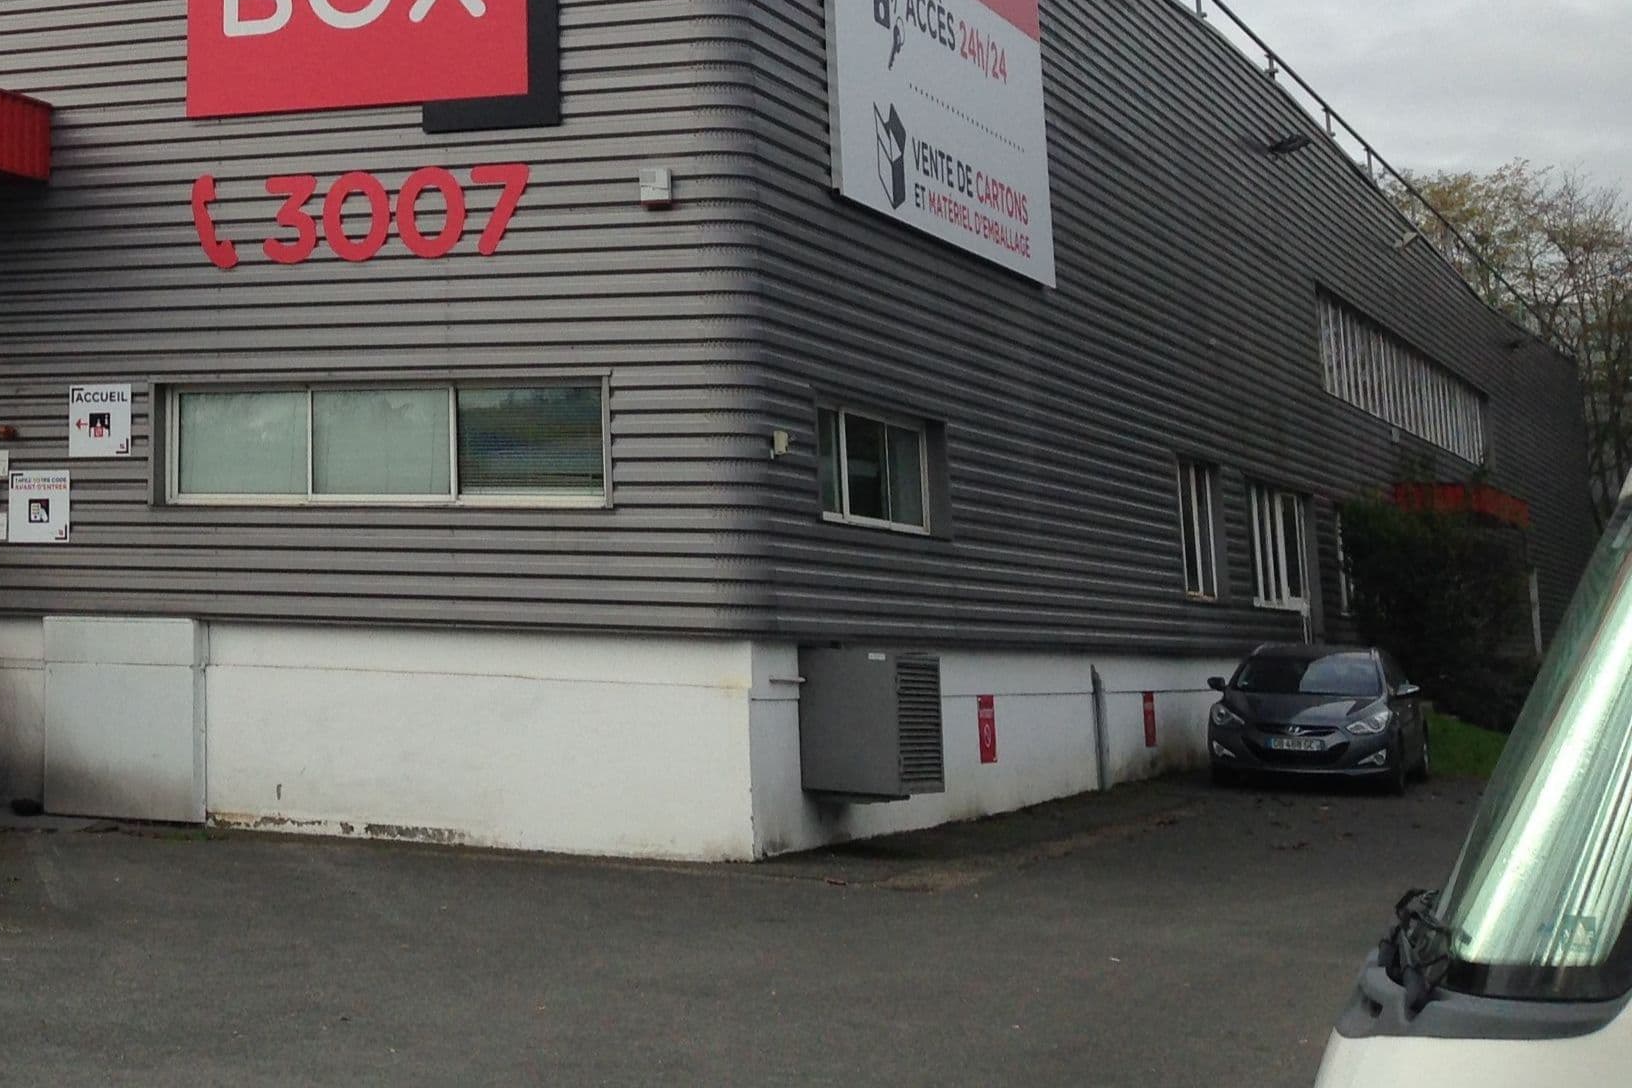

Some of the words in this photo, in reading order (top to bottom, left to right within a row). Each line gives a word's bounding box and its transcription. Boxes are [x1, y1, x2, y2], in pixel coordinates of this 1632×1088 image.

[959, 20, 1008, 85] 24h/24
[262, 162, 530, 265] 3007
[912, 136, 954, 190] VENTE
[957, 163, 974, 198] DE
[975, 170, 1030, 226] CARTONS
[914, 182, 926, 211] ET
[928, 189, 973, 232] MATÉRIEL
[974, 210, 1031, 260] D'EMBALLAGE
[75, 391, 128, 403] ACCUEIL
